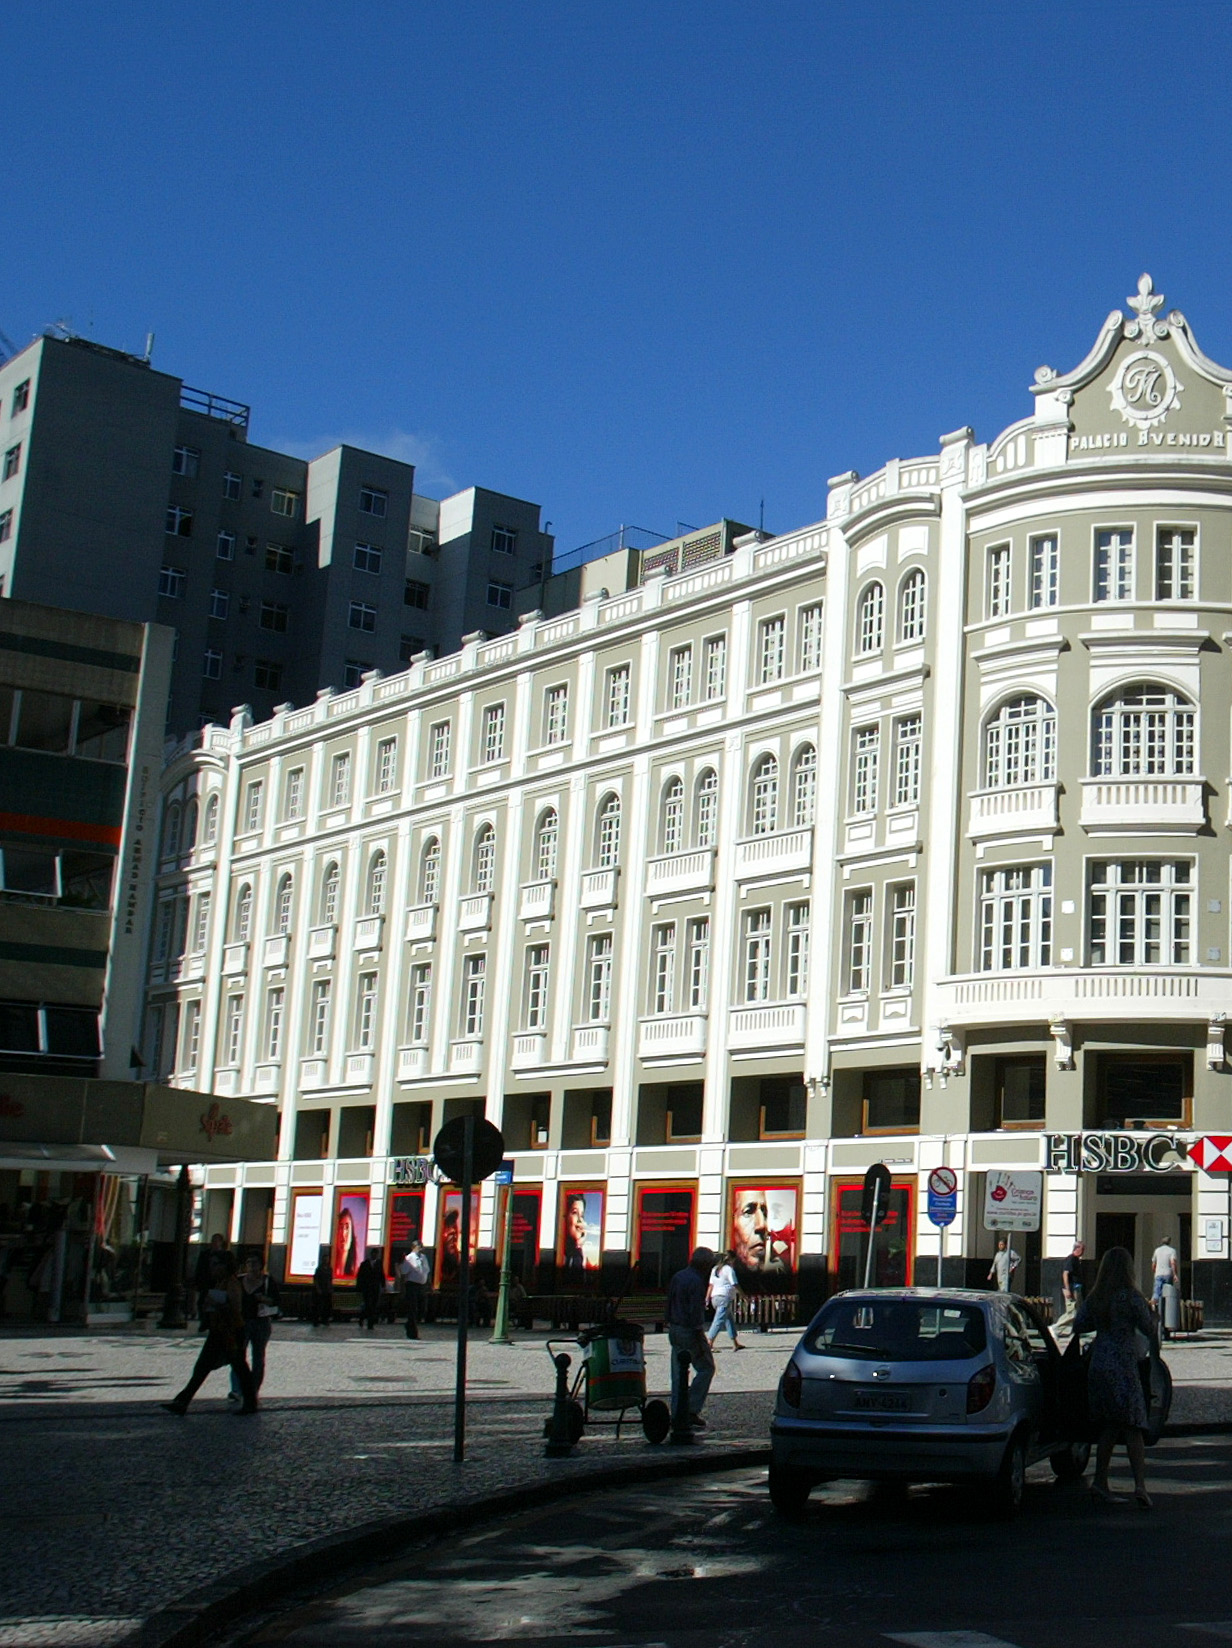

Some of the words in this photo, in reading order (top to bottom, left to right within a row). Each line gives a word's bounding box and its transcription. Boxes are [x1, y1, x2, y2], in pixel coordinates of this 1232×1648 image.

[1070, 432, 1128, 451] PALACIO
[1137, 429, 1225, 448] AVENIDA
[1043, 1133, 1179, 1173] HSBC
